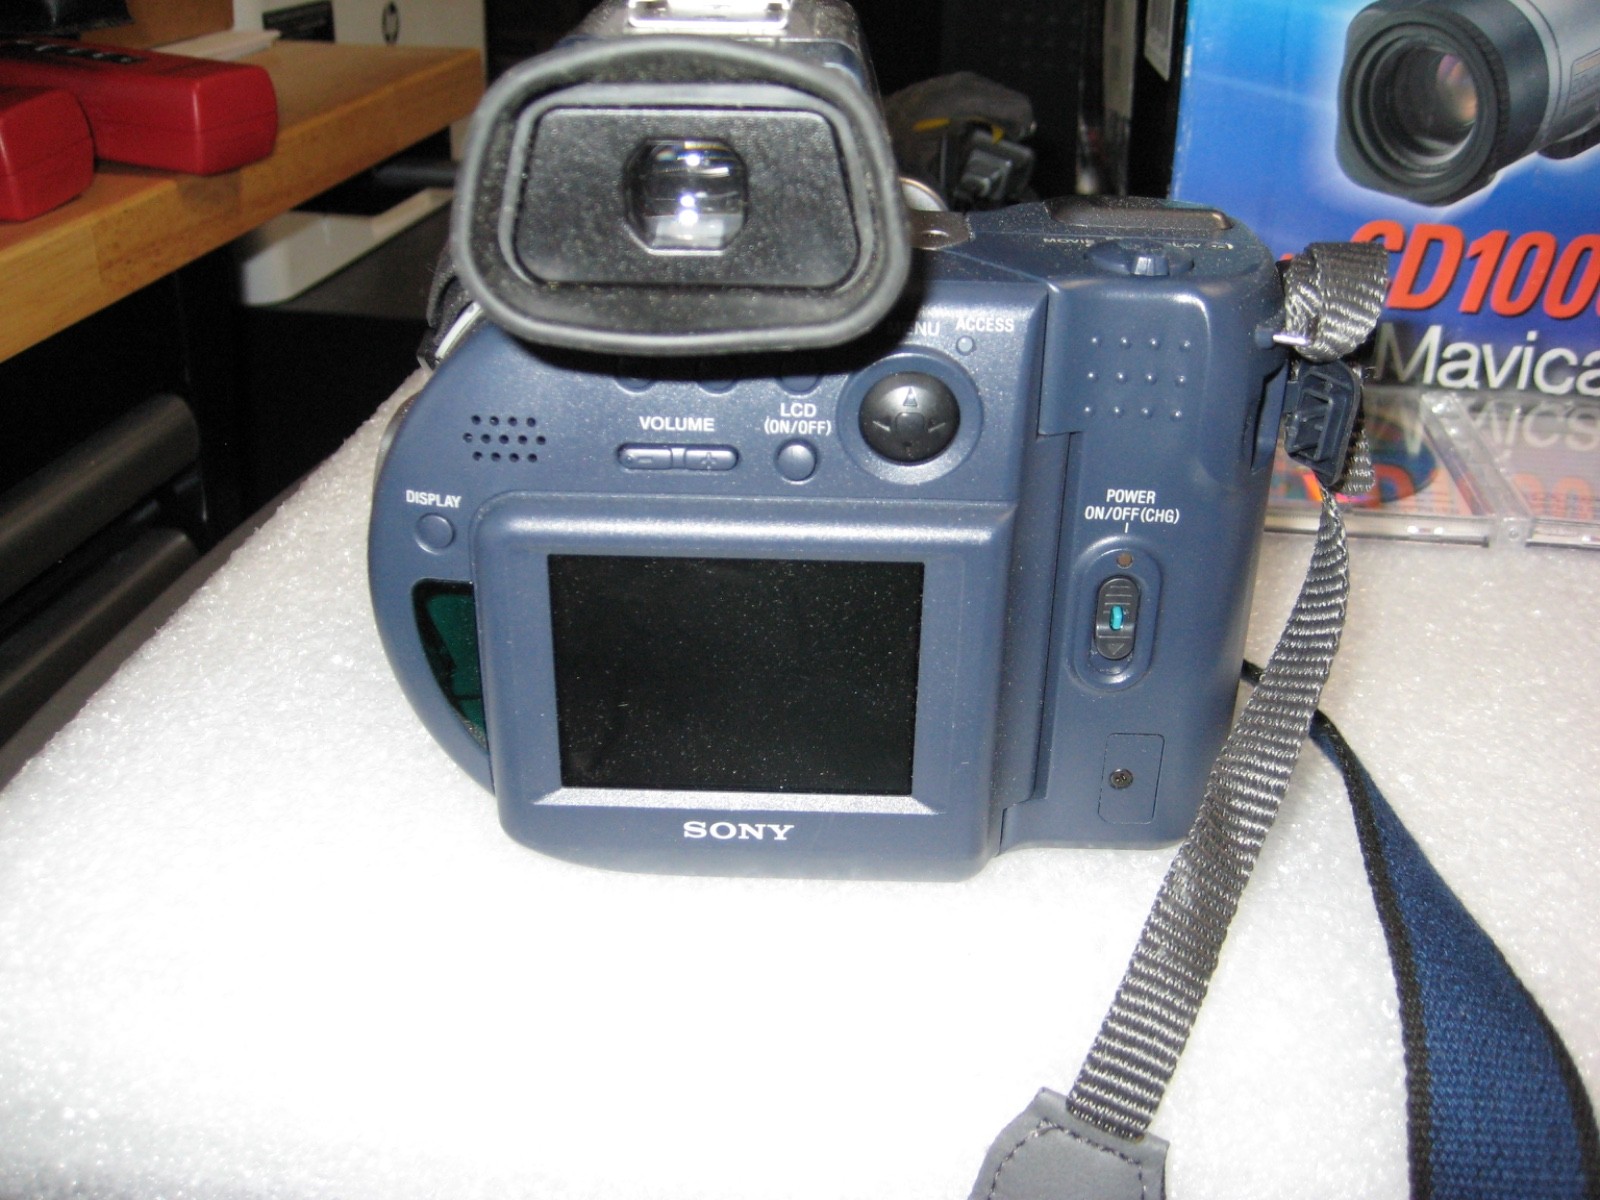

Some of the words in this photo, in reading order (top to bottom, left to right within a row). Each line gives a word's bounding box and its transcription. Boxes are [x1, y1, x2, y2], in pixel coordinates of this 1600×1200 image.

[1350, 219, 1600, 319] D100
[908, 320, 941, 337] NU
[956, 317, 1015, 332] ACCESS
[780, 402, 817, 417] LCD
[639, 416, 715, 432] VOLUME
[763, 416, 832, 436] (ON/OFF)
[405, 489, 462, 508] DISPLAY
[1106, 488, 1156, 504] POWER
[683, 821, 795, 840] SONY
